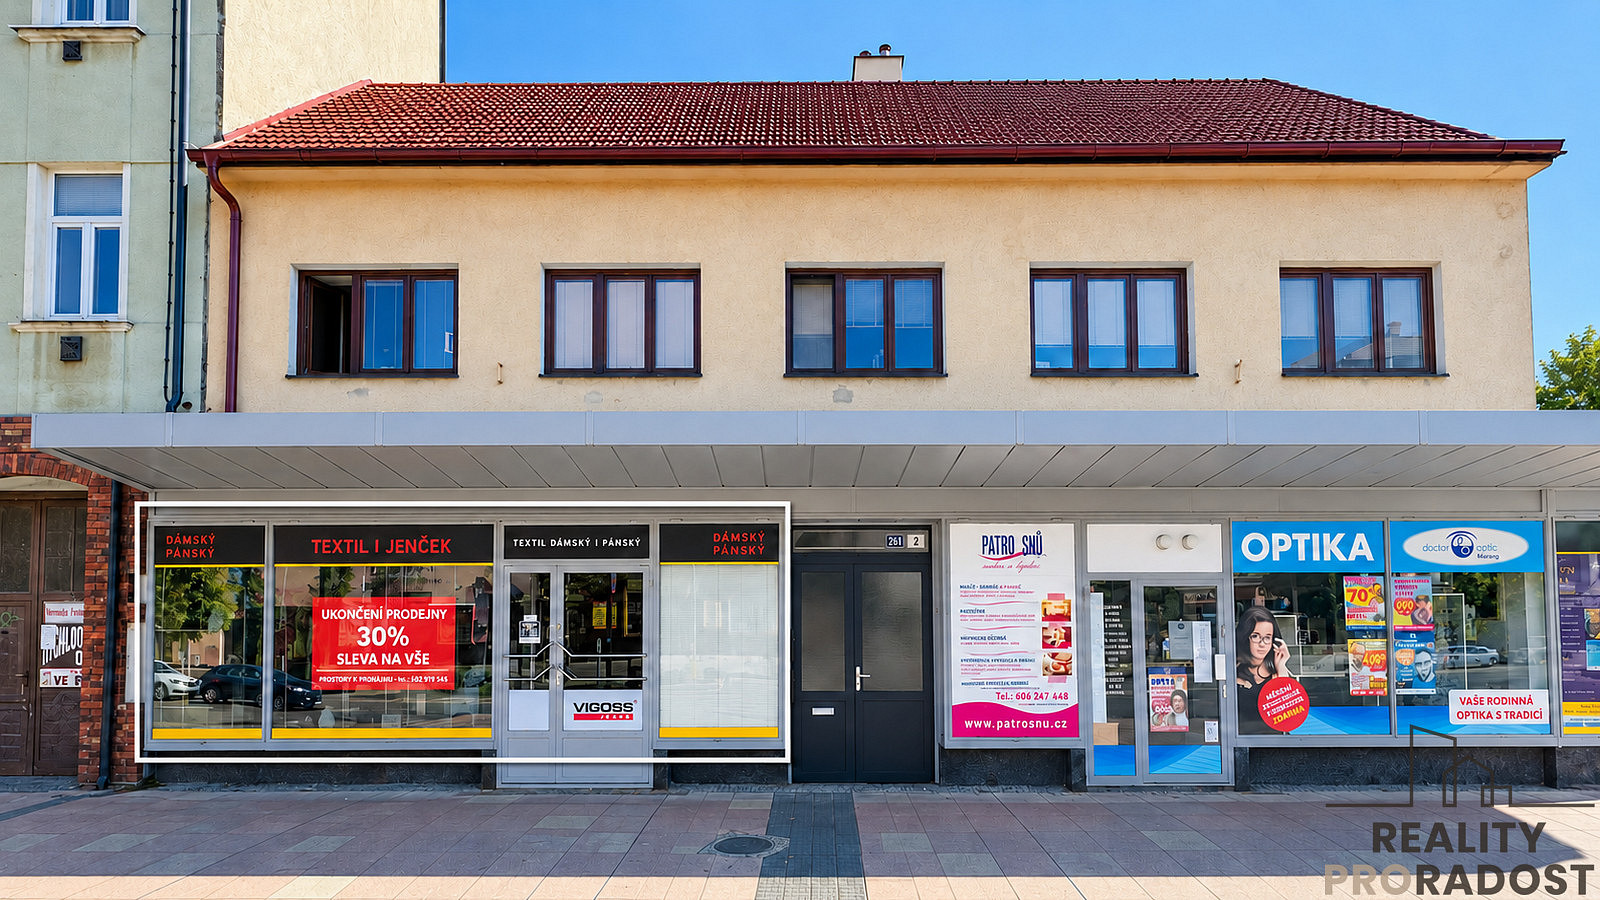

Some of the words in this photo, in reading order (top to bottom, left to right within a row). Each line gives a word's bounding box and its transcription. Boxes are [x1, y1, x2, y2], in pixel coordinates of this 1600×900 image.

[166, 533, 215, 545] DÁMSKÝ
[513, 539, 546, 547] TEXTIL
[550, 537, 591, 547] DÁMSKÝ
[602, 537, 641, 547] PÁNSKÝ
[713, 530, 765, 542] DÁMSKÝ
[888, 536, 902, 546] 261
[914, 536, 920, 546] 2
[311, 539, 369, 554] TEXTIL
[375, 539, 379, 554] I
[386, 535, 452, 554] JENČEK
[981, 535, 1015, 556] PATRO
[1022, 530, 1043, 556] SNŮ
[1241, 532, 1374, 562] OPTIKA
[1422, 543, 1449, 552] doctor
[166, 546, 215, 558] PÁNSKÝ
[713, 544, 765, 556] PÁNSKÝ
[321, 606, 383, 620] UKONČENÍ
[386, 608, 448, 620] PRODEJNY
[357, 625, 410, 647] 30%
[336, 653, 378, 666] SLEVA
[381, 653, 402, 666] NA
[404, 650, 430, 666] VŠE
[54, 675, 68, 686] VE
[995, 692, 1013, 701] Tel.:
[1015, 692, 1032, 701] 606
[1033, 692, 1049, 701] 247
[1052, 692, 1069, 701] 448
[1459, 694, 1485, 706] VAŠE
[1487, 694, 1534, 706] RODINNÁ
[573, 702, 634, 713] VIGOSS
[1456, 711, 1493, 720] OPTIKA
[1495, 711, 1502, 720] S
[1503, 708, 1543, 720] TRADICÍ
[964, 719, 1068, 731] www.patrosnu.cz
